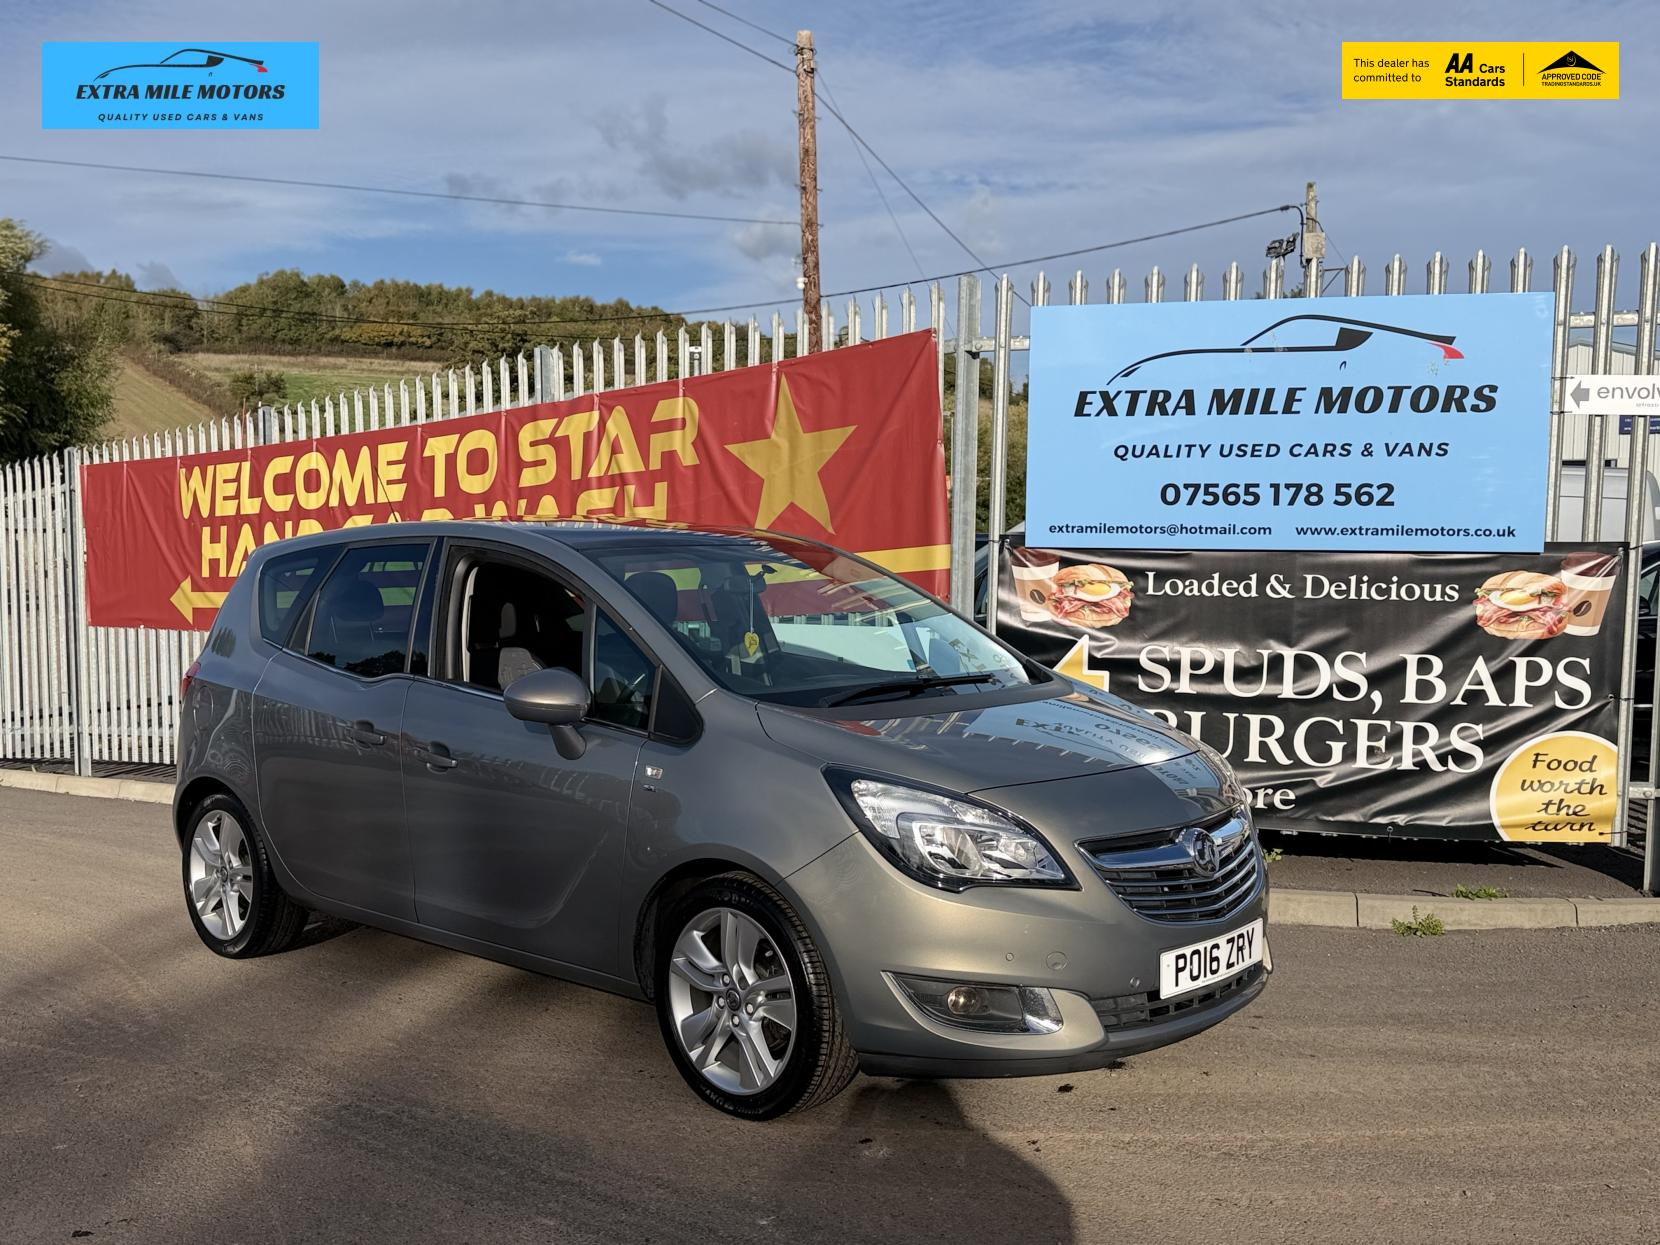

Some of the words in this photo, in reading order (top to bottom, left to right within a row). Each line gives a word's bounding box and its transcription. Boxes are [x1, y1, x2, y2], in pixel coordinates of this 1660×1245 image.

[1073, 389, 1196, 418] EXTRA
[1206, 386, 1307, 416] MILE
[1313, 384, 1499, 415] MOTORS
[179, 441, 408, 519] WELCOME
[423, 429, 497, 497] TO
[518, 396, 699, 487] STAR
[1113, 443, 1212, 462] QUALITY
[1218, 443, 1281, 458] USED
[1288, 442, 1353, 458] CARS
[1360, 442, 1374, 458] &
[1384, 441, 1450, 458] VANS
[1160, 482, 1261, 507] 07565
[1269, 482, 1324, 507] 178
[1332, 482, 1395, 507] 562
[1048, 522, 1272, 537] extramilemotors@hotmail.com
[1295, 523, 1516, 538] www.extramilemotors.co.uk
[1145, 571, 1259, 599] Loaded
[1265, 574, 1296, 599] &
[1303, 575, 1459, 602] Delicious
[1137, 645, 1383, 715] SPUDS,
[1399, 653, 1592, 710] BAPS
[1144, 708, 1485, 774] URGERS
[1531, 752, 1598, 773] Food
[1520, 777, 1608, 796] worth
[1536, 798, 1591, 818] the
[1524, 820, 1596, 832] turn
[1174, 942, 1221, 988] PO16
[1225, 926, 1255, 970] ZRY
